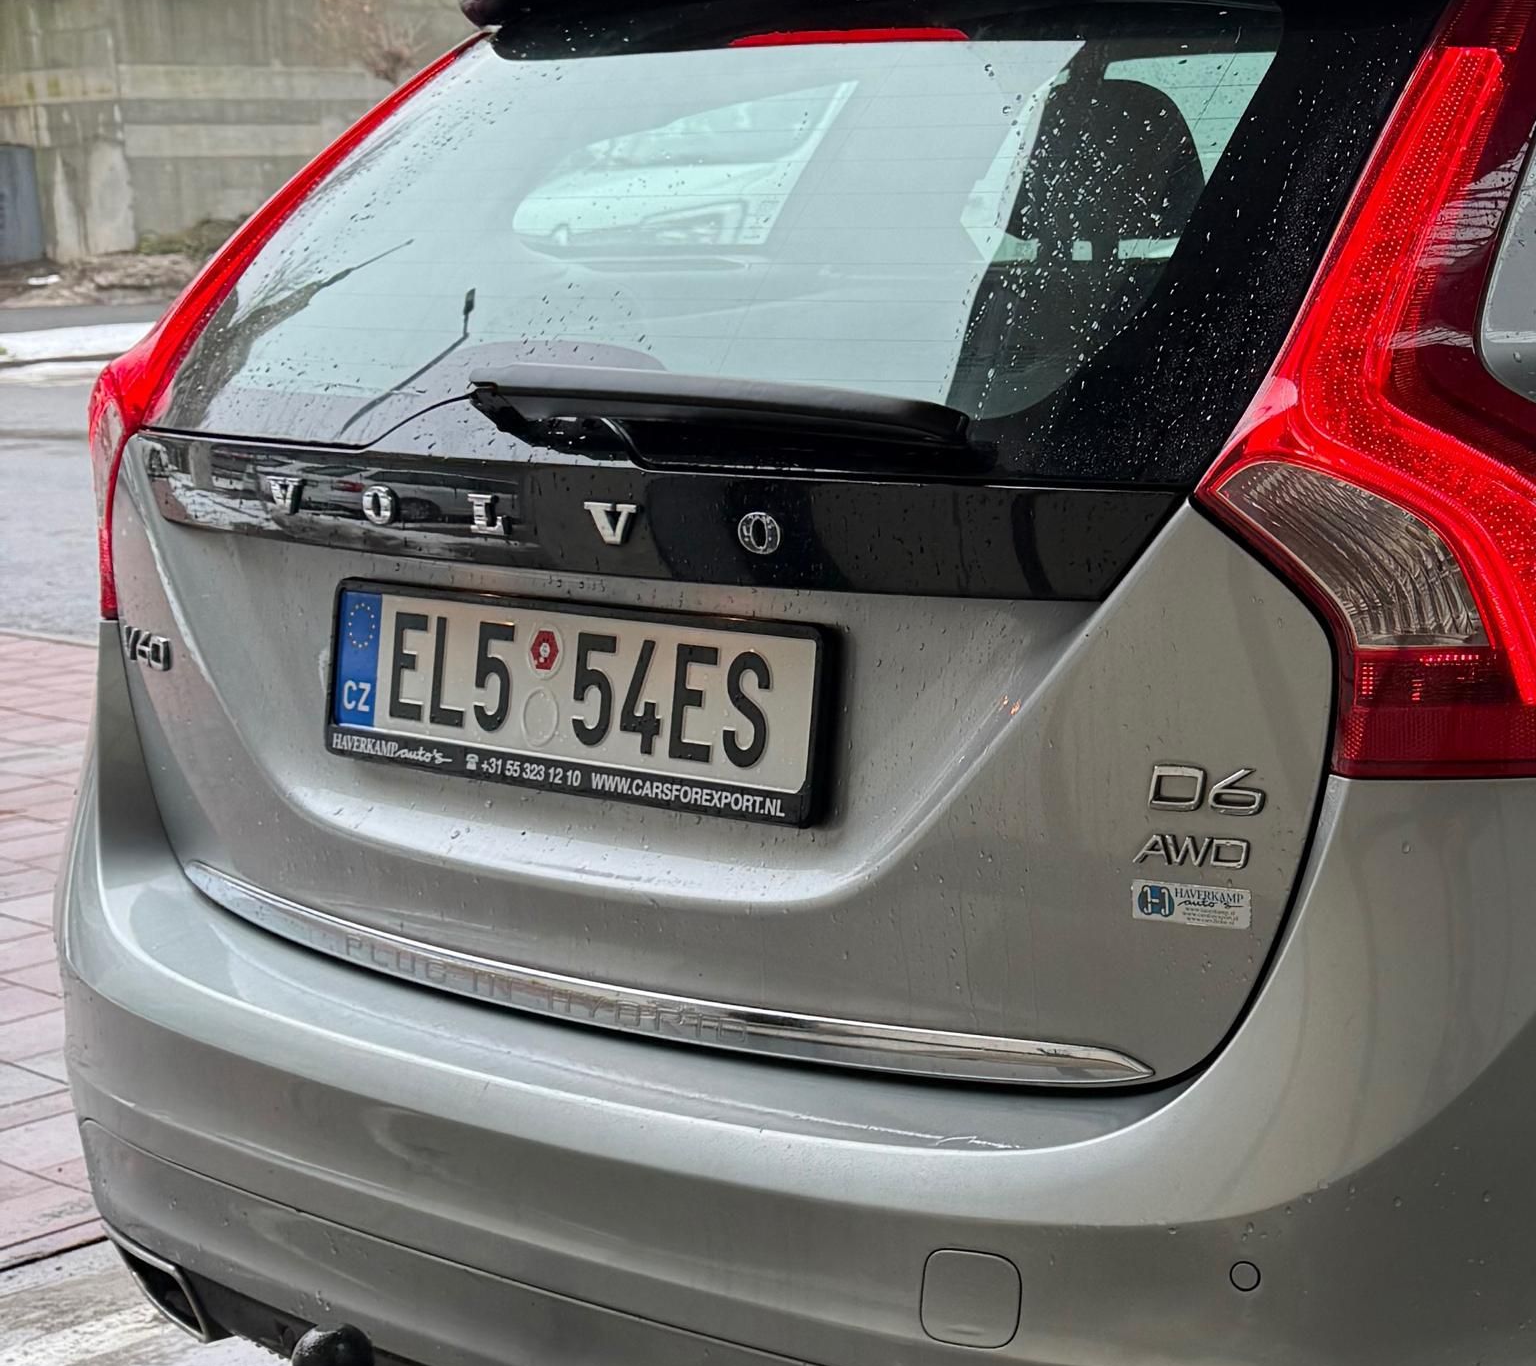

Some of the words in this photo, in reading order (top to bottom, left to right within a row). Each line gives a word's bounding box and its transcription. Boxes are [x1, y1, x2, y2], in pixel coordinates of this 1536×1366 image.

[267, 476, 781, 554] VOLVO
[124, 625, 171, 671] V60
[343, 681, 371, 712] CZ
[389, 611, 515, 732] EL5
[571, 632, 771, 768] 54ES
[332, 733, 398, 757] HAVERKAMP
[481, 758, 502, 774] +31
[506, 761, 520, 777] 55
[522, 763, 545, 781] 323
[548, 767, 563, 784] 12
[566, 769, 581, 786] 10
[1148, 763, 1266, 816] D6
[591, 773, 786, 817] WWW.CARSFOREXPORT.NL
[1133, 834, 1251, 869] AWD
[1175, 888, 1244, 904] HAVERKAMP
